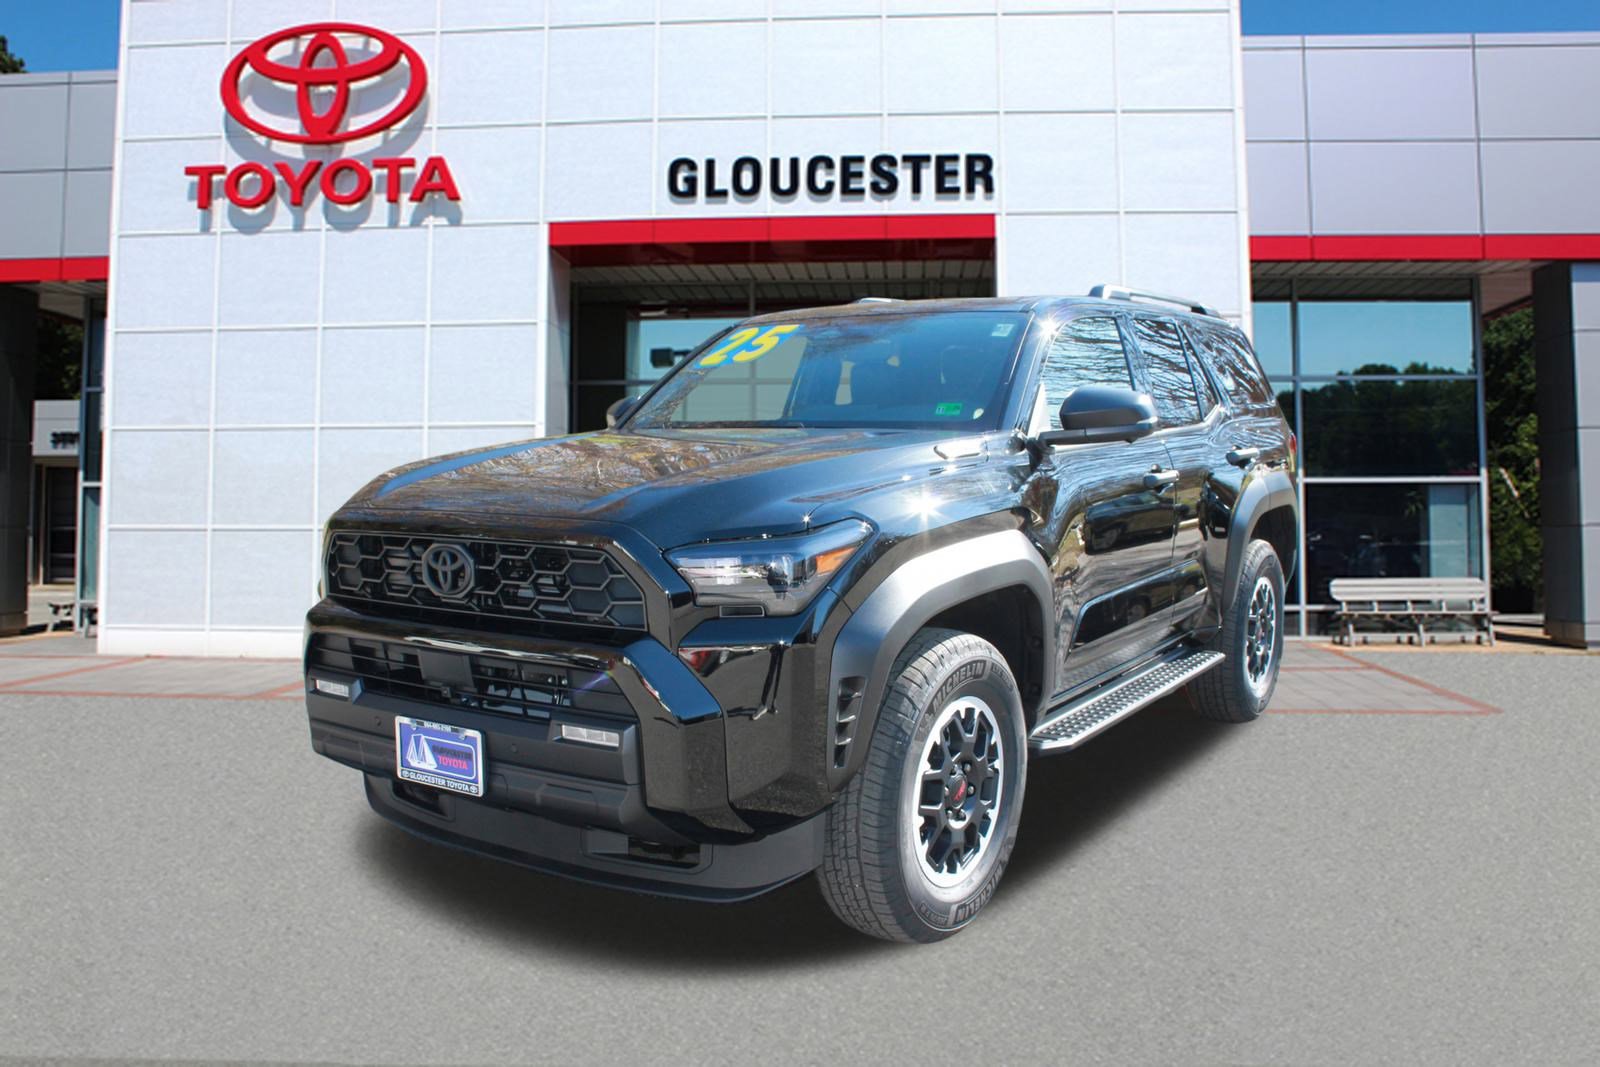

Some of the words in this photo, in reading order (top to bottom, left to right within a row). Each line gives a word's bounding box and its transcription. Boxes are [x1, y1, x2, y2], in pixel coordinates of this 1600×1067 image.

[184, 156, 461, 210] TOYOTA
[667, 153, 994, 200] GLOUCESTER
[700, 324, 800, 366] 25
[931, 661, 985, 712] MICHELIN
[409, 770, 446, 788] GLOUCESTER
[446, 780, 470, 792] TOYOTA
[438, 755, 468, 770] TOYOTA
[956, 863, 1004, 922] MICHELIN
